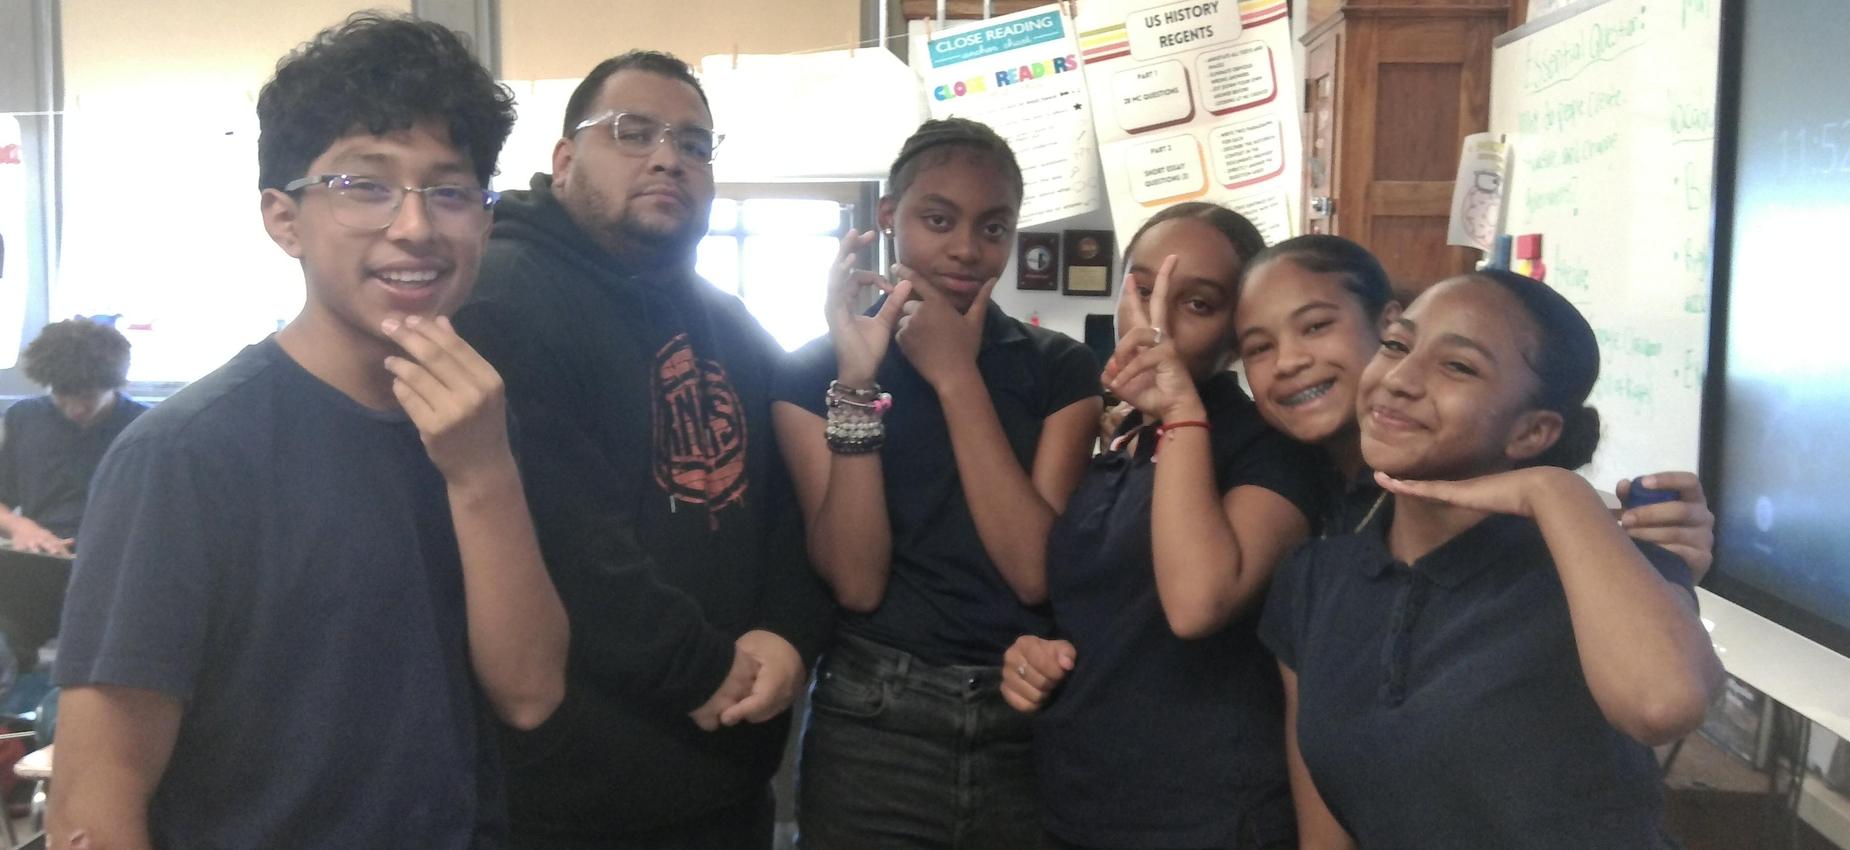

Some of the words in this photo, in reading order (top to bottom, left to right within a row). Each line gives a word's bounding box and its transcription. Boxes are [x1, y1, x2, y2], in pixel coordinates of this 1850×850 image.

[1145, 14, 1162, 28] US
[1164, 1, 1220, 25] HISTORY
[936, 33, 983, 53] CLOSE
[986, 17, 1053, 41] READING
[1159, 26, 1214, 48] REGENTS
[934, 75, 986, 101] CLOSE
[995, 54, 1078, 88] READERS
[1137, 71, 1153, 80] PART
[1143, 87, 1179, 100] QUESTIONS
[1150, 145, 1166, 154] PART
[1144, 166, 1166, 177] SHORT
[1166, 162, 1186, 172] ESSAY
[1144, 174, 1181, 187] QUESTIONS
